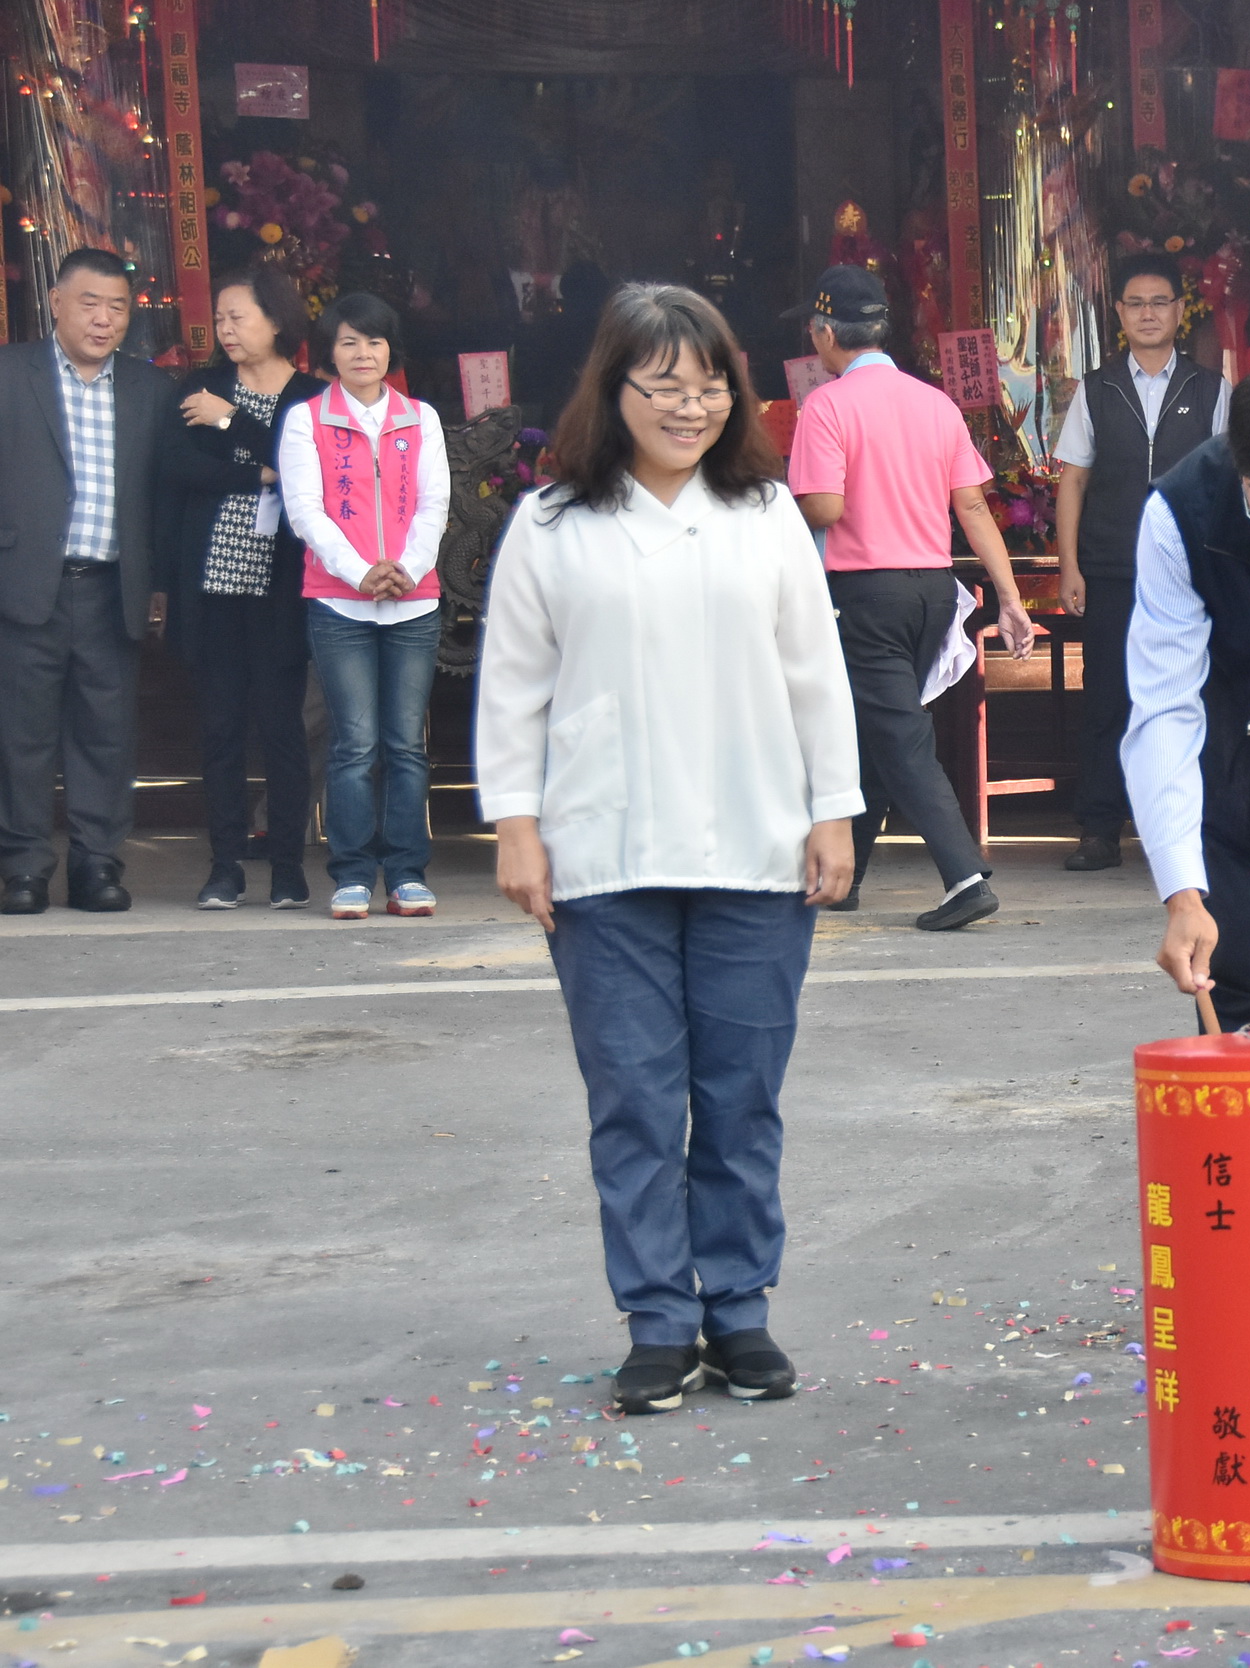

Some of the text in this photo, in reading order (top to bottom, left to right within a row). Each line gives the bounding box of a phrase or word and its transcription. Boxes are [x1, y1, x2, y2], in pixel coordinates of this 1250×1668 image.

[334, 453, 357, 520] 江秀春
[1146, 1181, 1180, 1414] 龍鳳呈祥
[1202, 1152, 1248, 1487] 信士 敬獻
